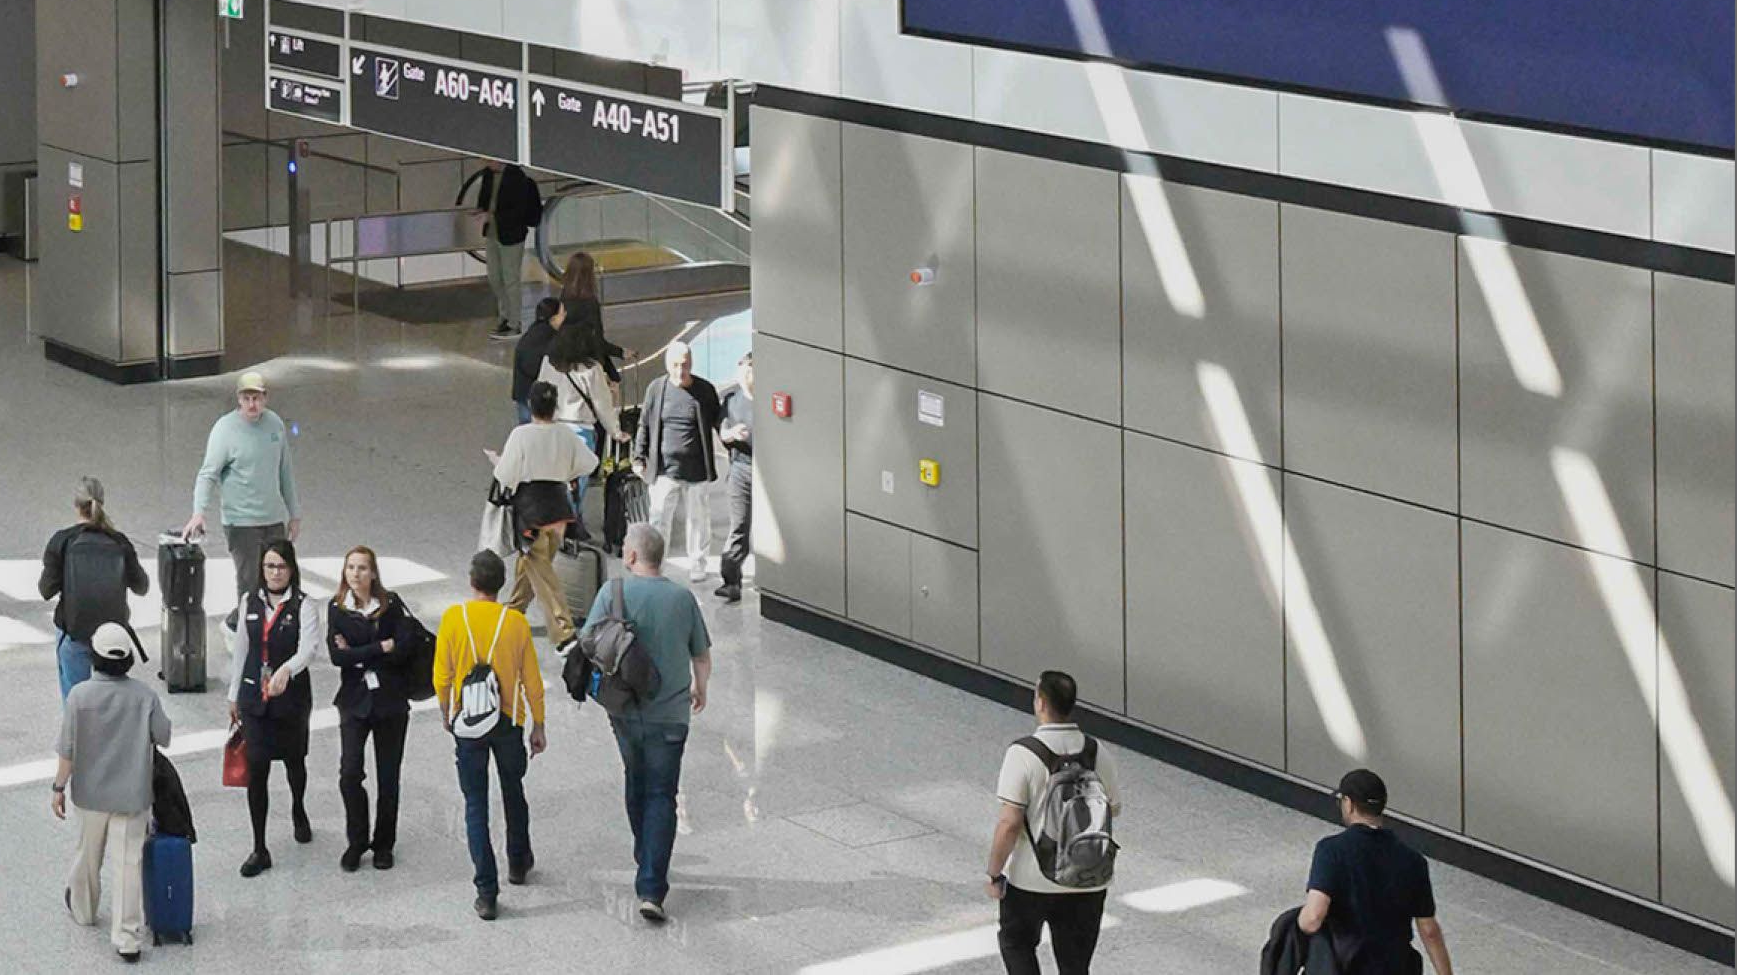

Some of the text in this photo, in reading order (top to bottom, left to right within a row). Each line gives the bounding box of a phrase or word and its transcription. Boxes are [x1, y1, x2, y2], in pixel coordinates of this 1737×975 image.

[403, 61, 515, 110] Gate A60-A64
[557, 91, 680, 144] Gate A40-A51
